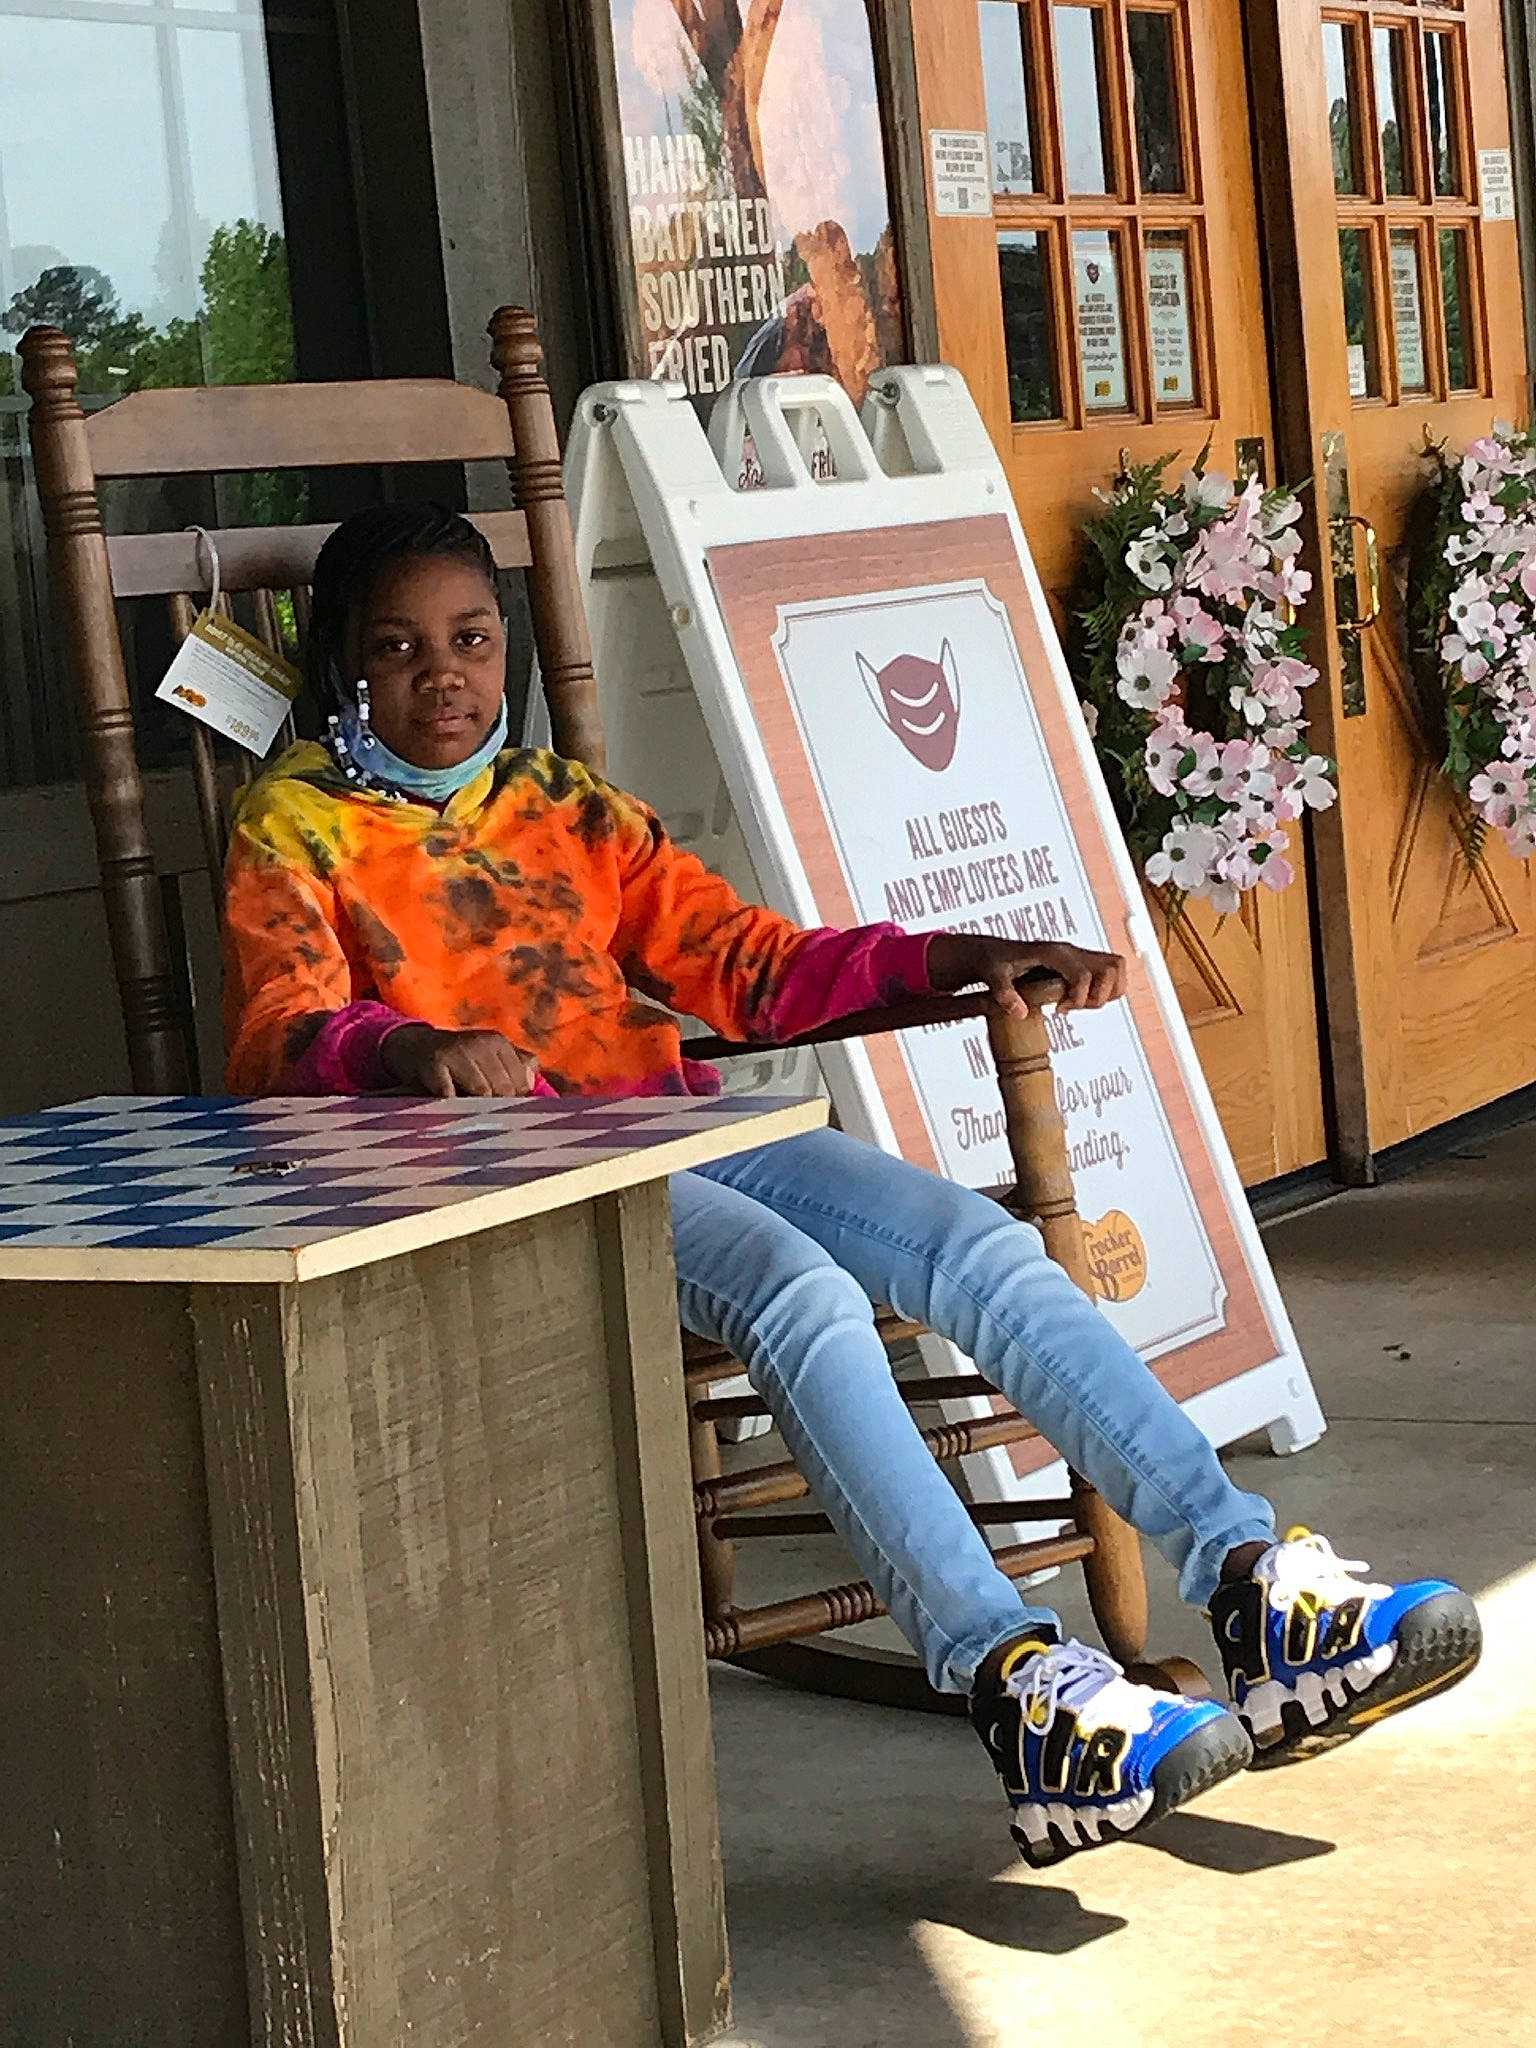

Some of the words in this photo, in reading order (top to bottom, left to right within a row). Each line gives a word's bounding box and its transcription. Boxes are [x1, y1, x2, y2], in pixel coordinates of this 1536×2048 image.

[625, 133, 707, 195] HAND
[630, 197, 774, 263] BATTERED
[640, 262, 788, 332] SOUTHERN
[648, 334, 731, 395] FRIED
[905, 815, 942, 860] ALL
[938, 800, 1007, 852] GUESTS
[884, 876, 925, 922] AND
[921, 852, 1025, 914] EMPLOYEES
[1022, 846, 1060, 890] ARE
[1007, 898, 1063, 942] WEAR
[1060, 895, 1079, 937] A
[962, 1034, 991, 1079] IN
[951, 1106, 1008, 1151] Than
[1089, 1065, 1133, 1118] your
